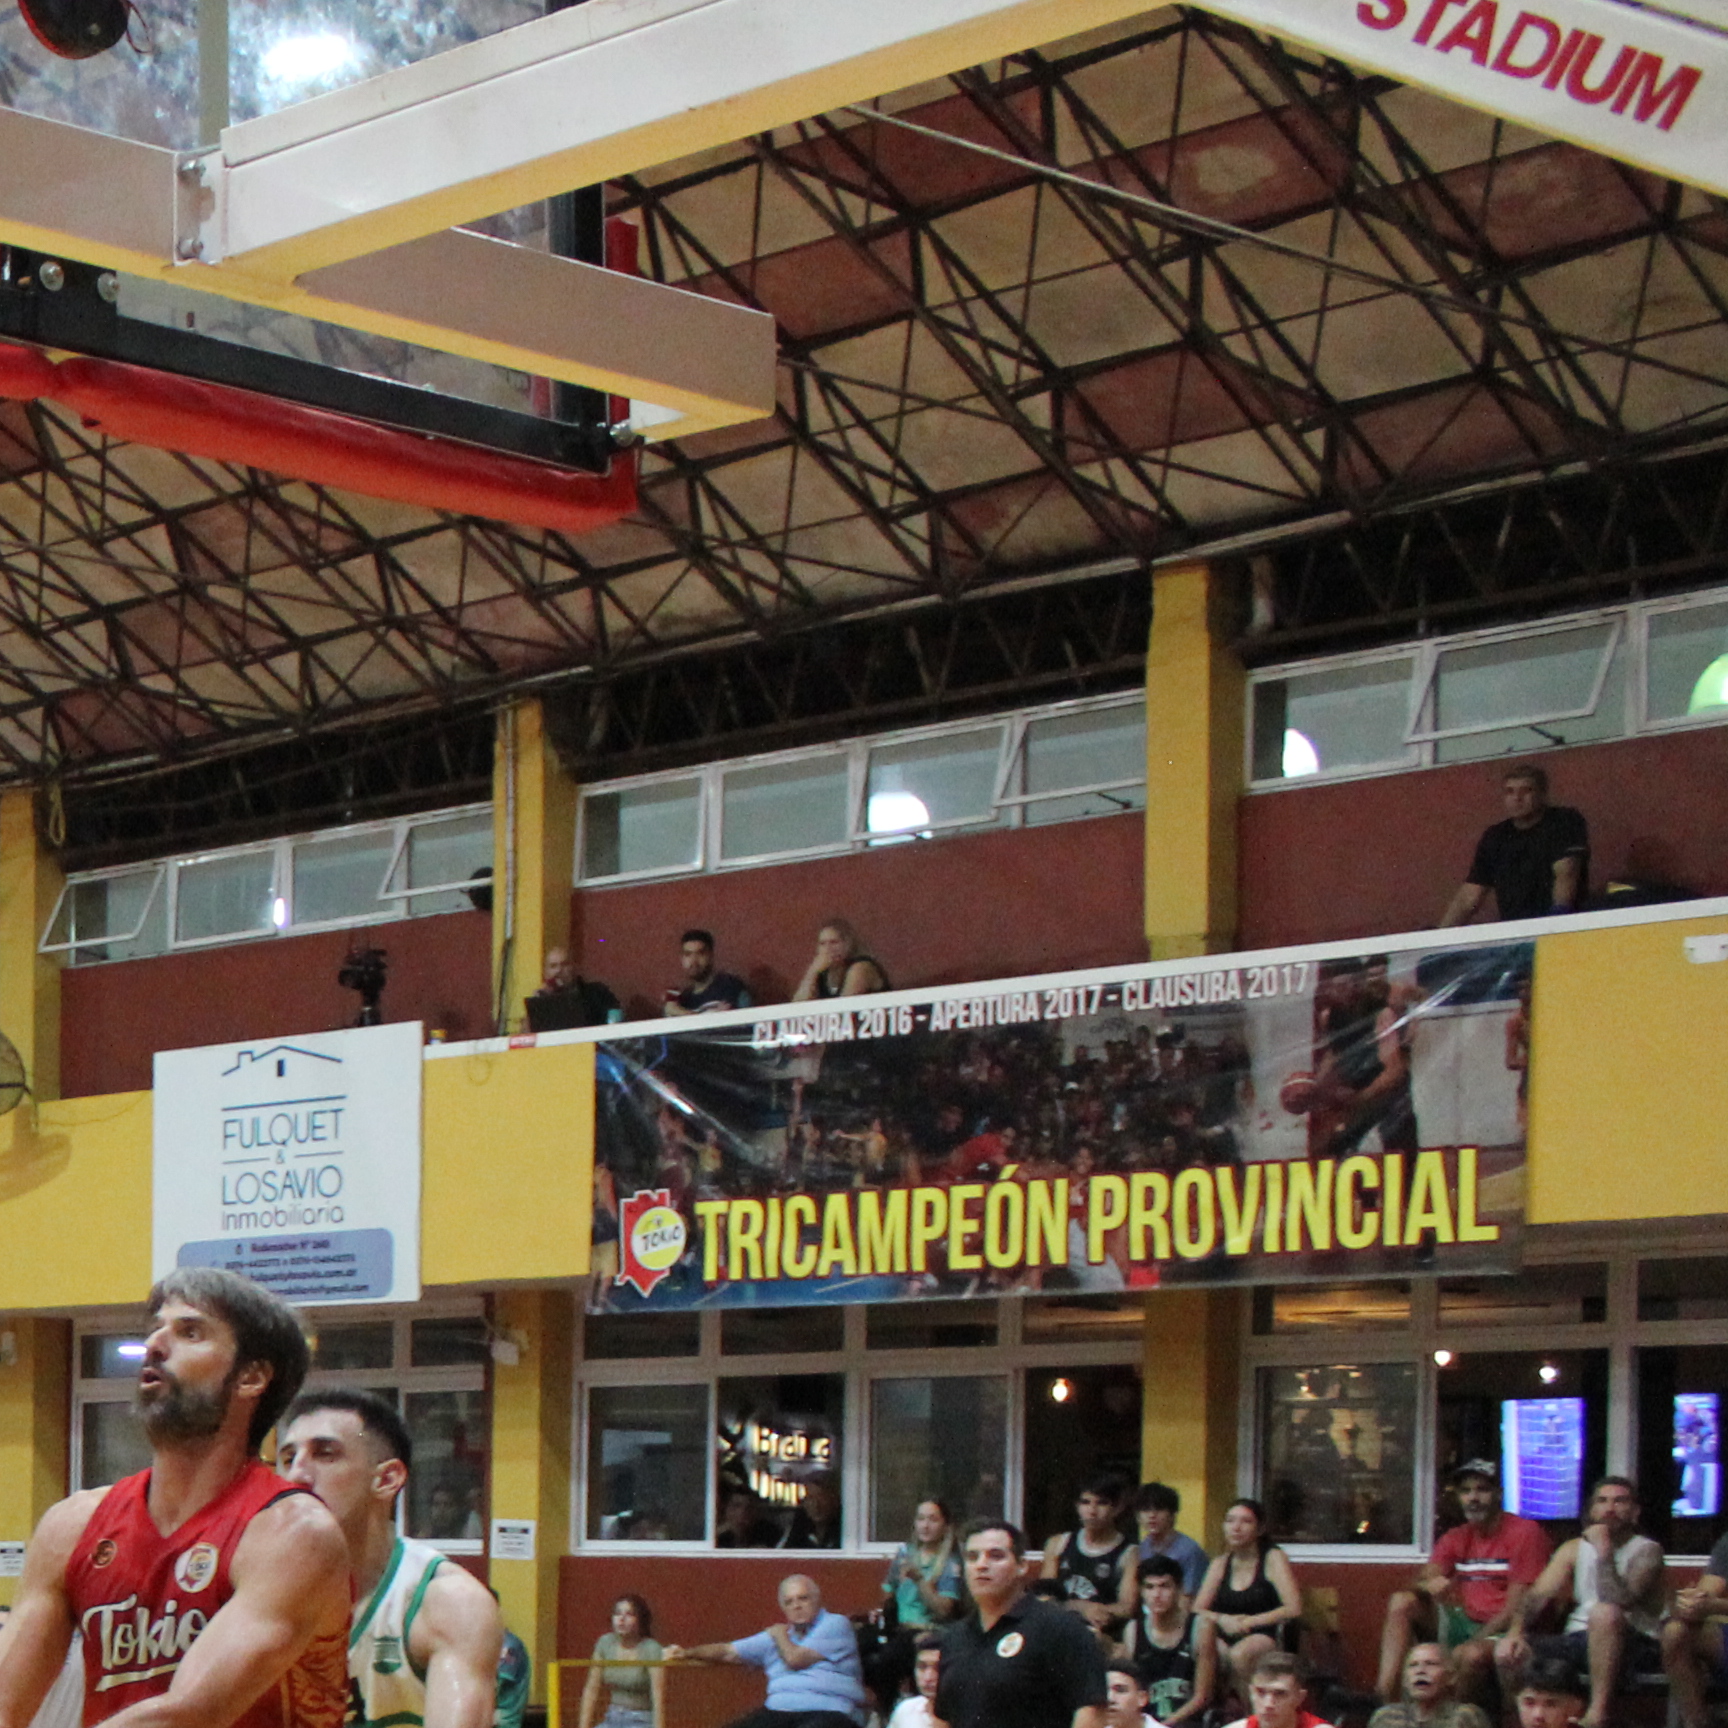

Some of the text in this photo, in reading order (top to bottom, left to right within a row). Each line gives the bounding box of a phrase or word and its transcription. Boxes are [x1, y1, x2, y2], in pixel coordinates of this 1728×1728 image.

[753, 1008, 854, 1049] CLAUSURA
[858, 1004, 913, 1040] 2016
[929, 992, 1040, 1032] APERTURA
[1044, 983, 1100, 1019] 2017
[1121, 969, 1242, 1011] CLAUSURA
[1247, 962, 1308, 999] 2017
[222, 1108, 345, 1151] FULQUET
[275, 1150, 285, 1165] &
[222, 1164, 344, 1206] LOSAVIO
[221, 1199, 345, 1231] Inmobiliaria
[693, 1147, 1501, 1282] TRICAMPEÓN PROVINCIAL
[82, 1594, 210, 1671] Tokio
